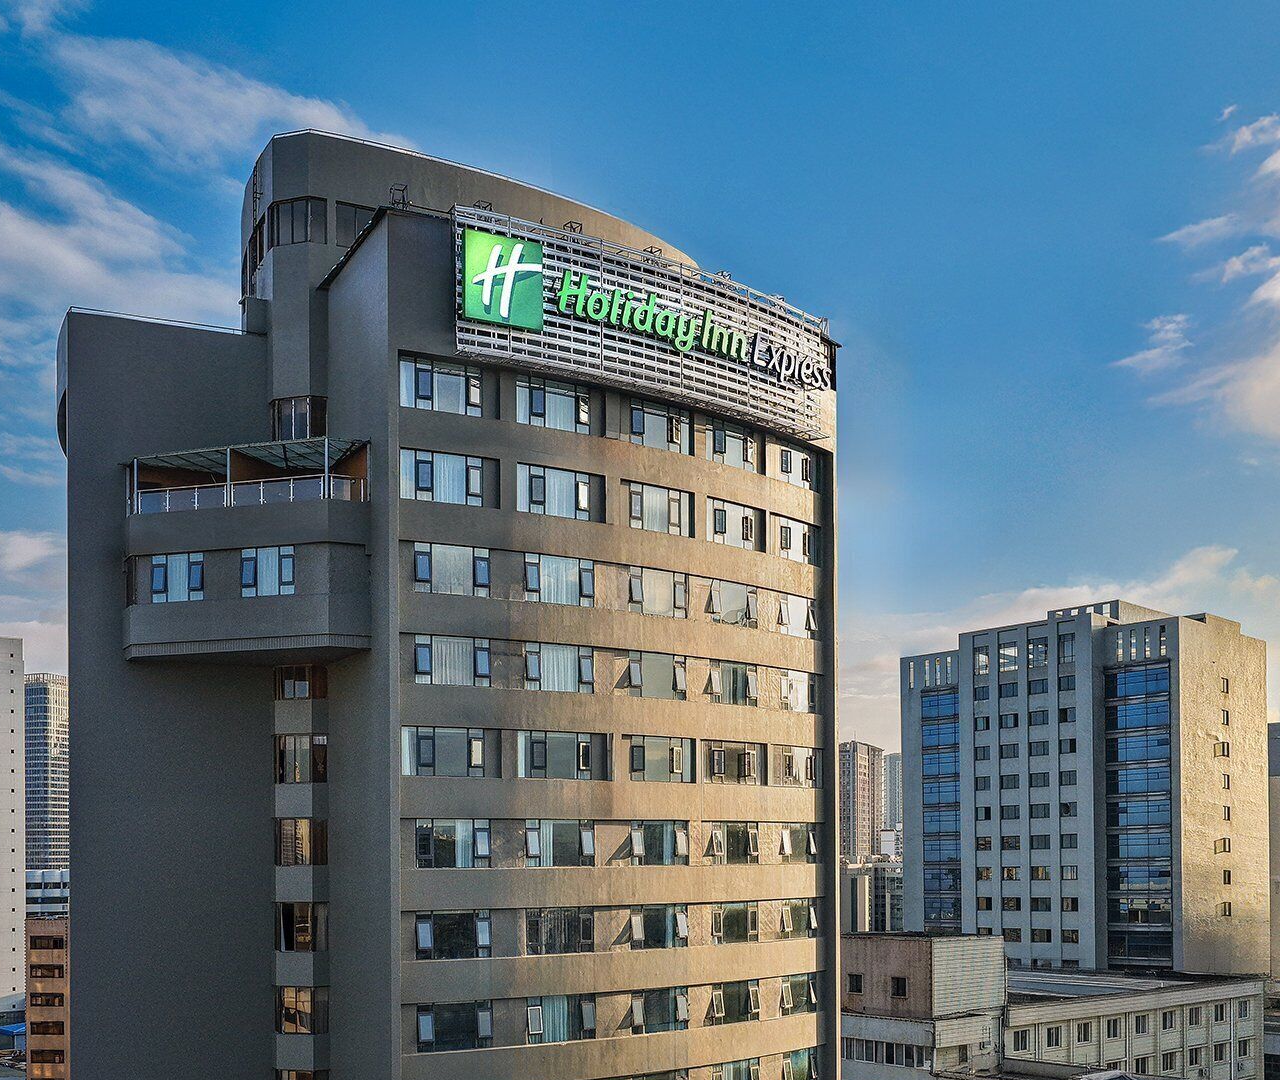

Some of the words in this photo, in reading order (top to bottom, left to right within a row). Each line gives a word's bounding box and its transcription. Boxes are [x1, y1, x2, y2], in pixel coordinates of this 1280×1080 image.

[557, 270, 698, 353] Holiday
[701, 309, 748, 363] Inn
[751, 332, 833, 391] Express
